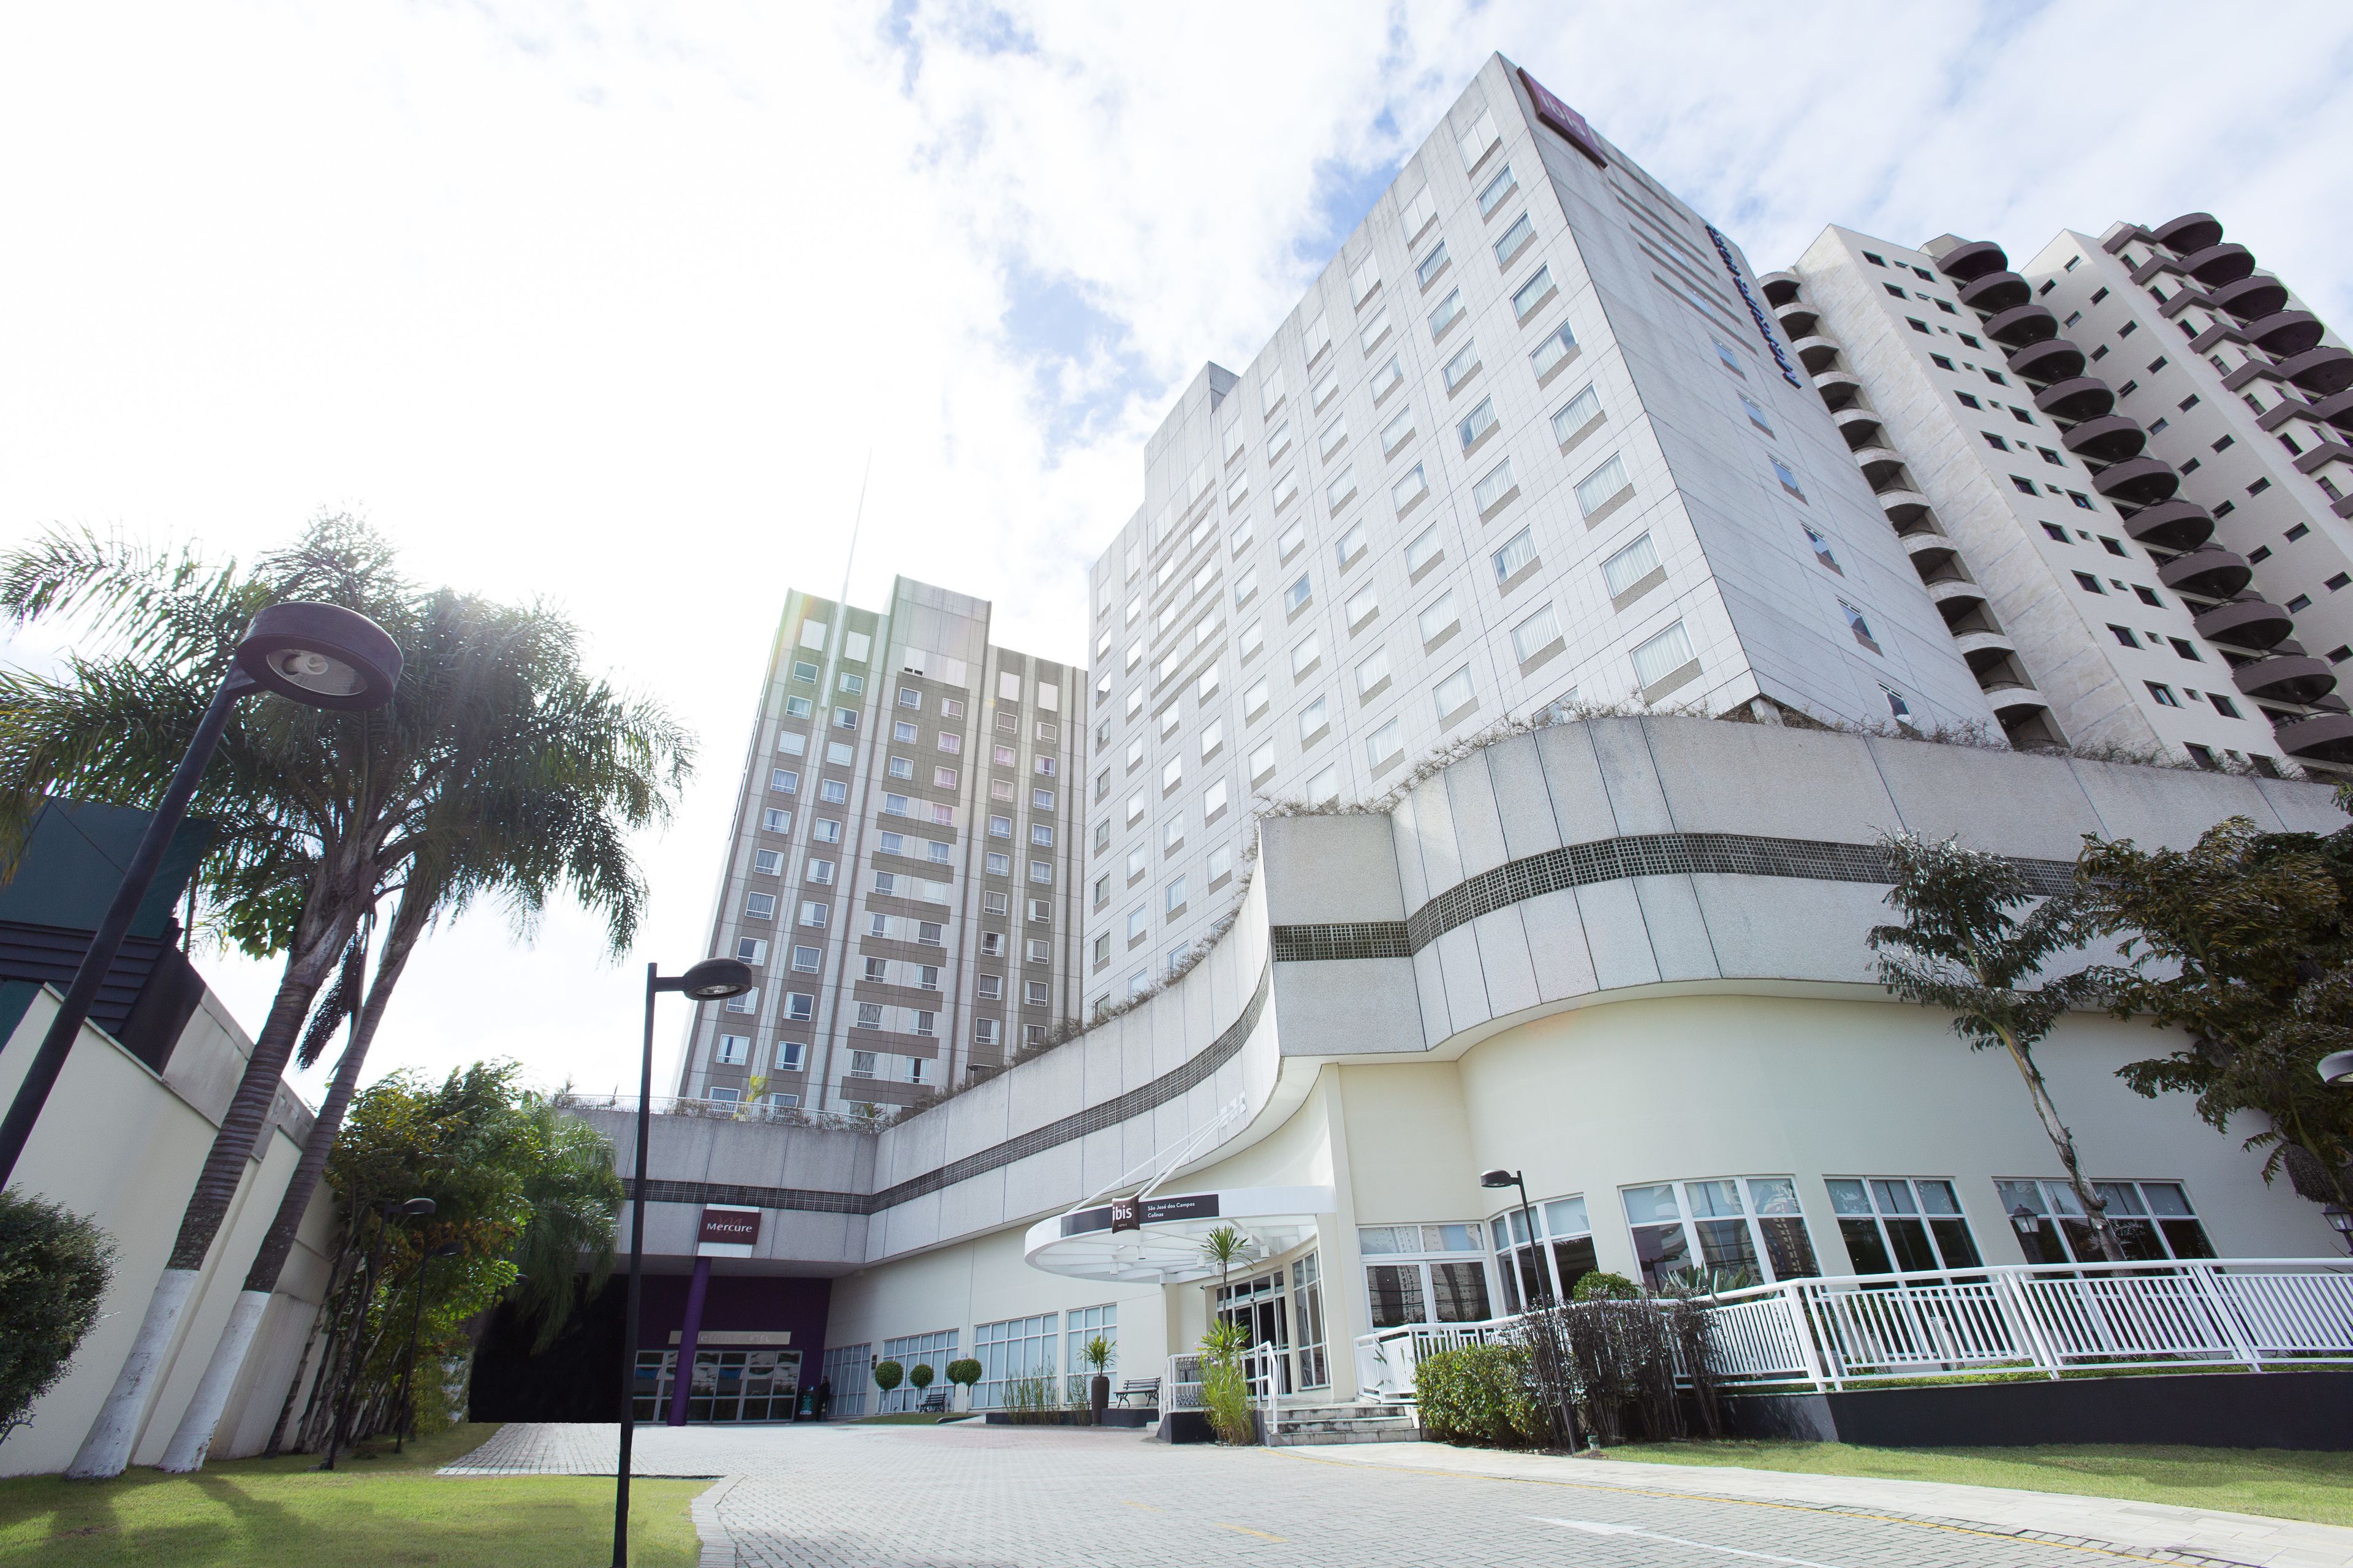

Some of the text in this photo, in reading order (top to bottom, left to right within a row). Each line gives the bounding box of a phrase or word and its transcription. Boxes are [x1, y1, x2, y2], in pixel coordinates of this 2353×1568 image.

[1539, 89, 1586, 137] ibis
[1733, 276, 1802, 390] Mercure
[707, 1222, 752, 1233] Mercure
[1112, 1205, 1132, 1221] ibis
